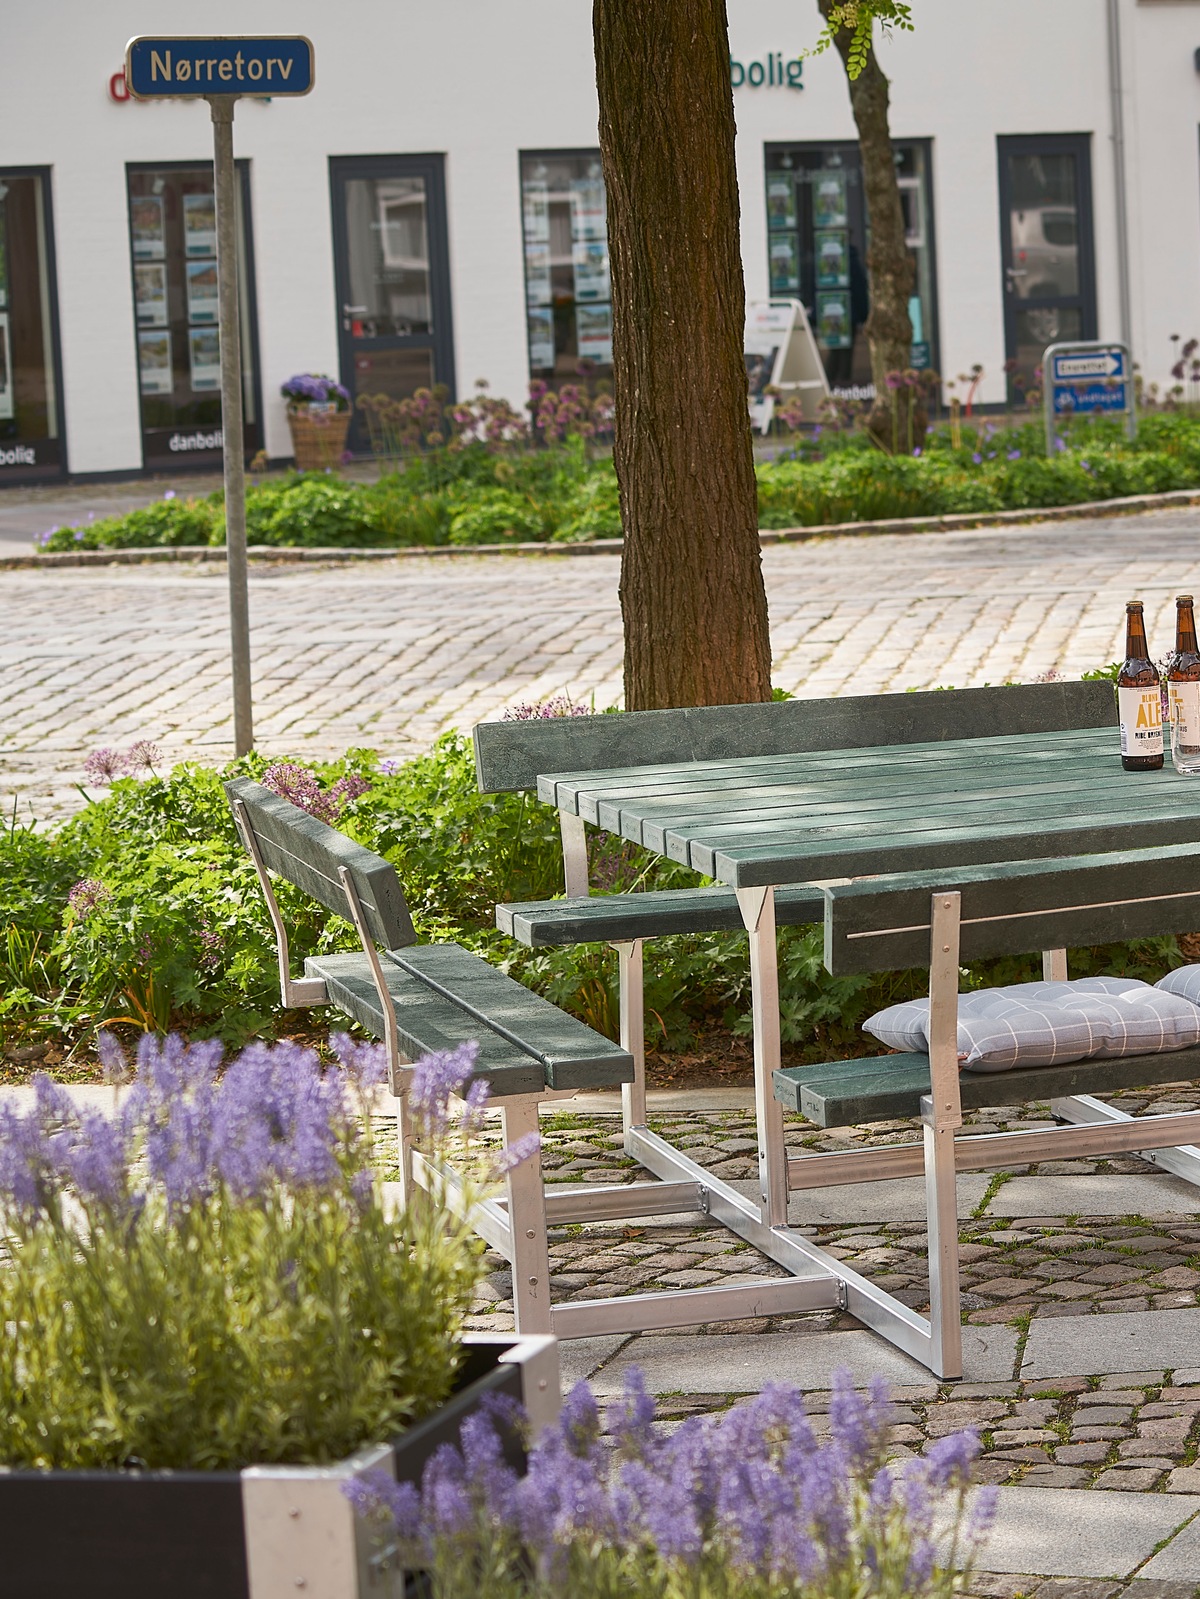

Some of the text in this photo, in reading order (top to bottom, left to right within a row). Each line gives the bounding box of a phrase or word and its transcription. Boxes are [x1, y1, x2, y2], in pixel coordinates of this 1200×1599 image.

[151, 50, 293, 81] Nørretorv
[730, 52, 804, 89] bolig
[169, 430, 224, 452] danboli
[0, 445, 36, 465] bolig
[1136, 702, 1162, 729] ALE
